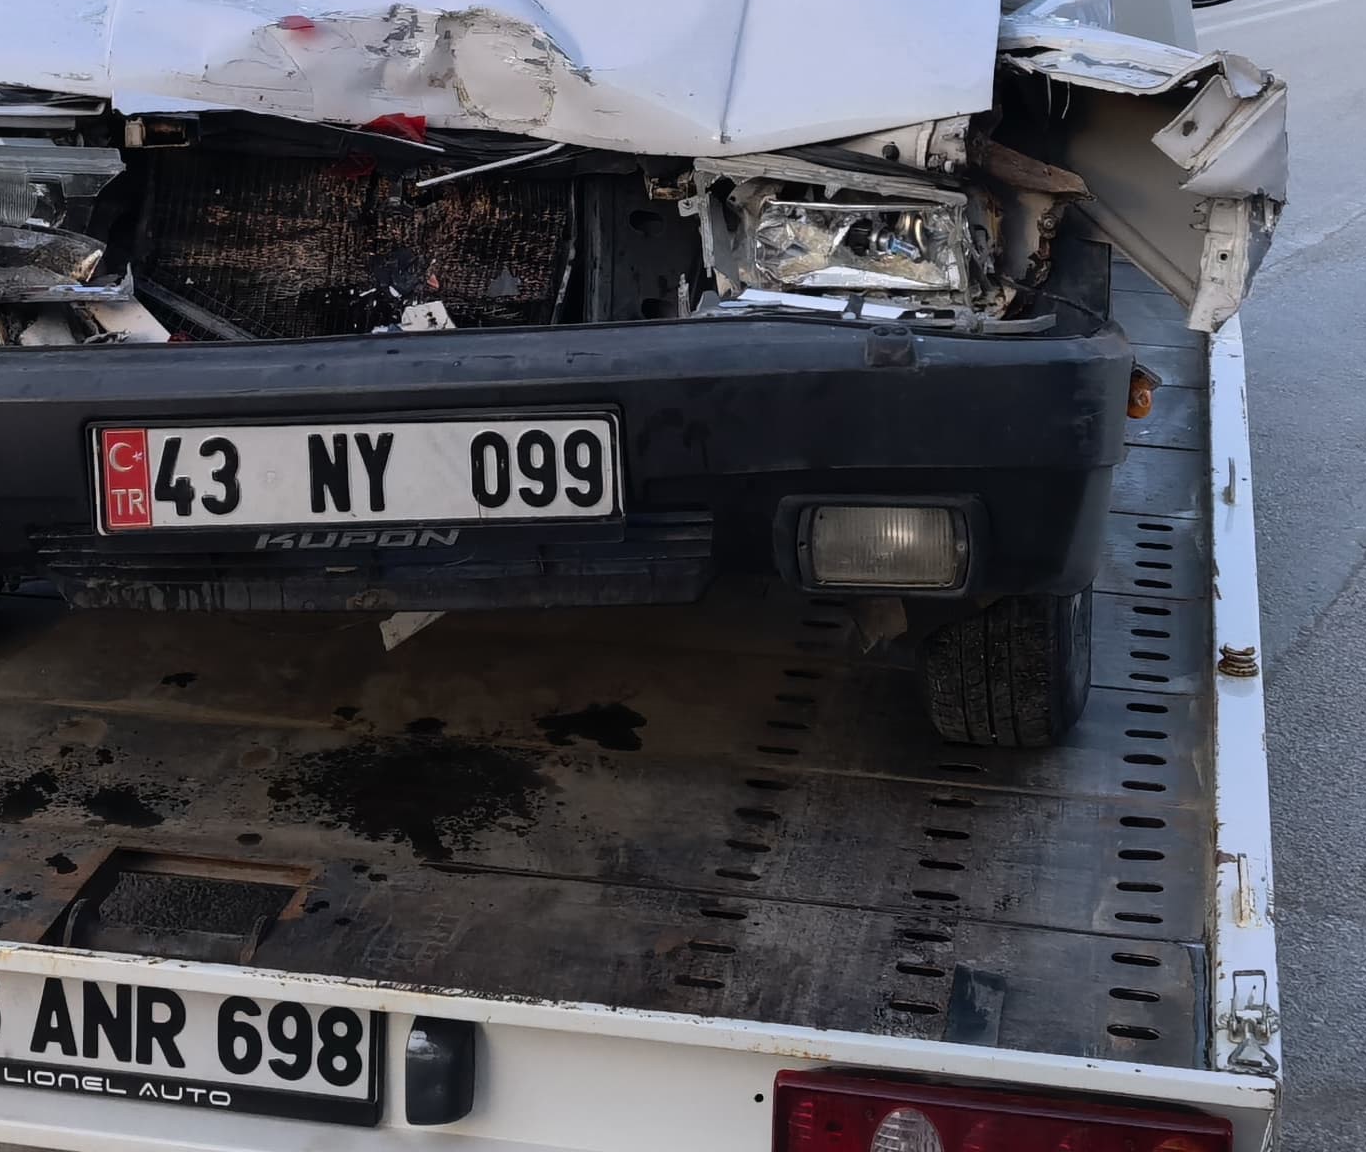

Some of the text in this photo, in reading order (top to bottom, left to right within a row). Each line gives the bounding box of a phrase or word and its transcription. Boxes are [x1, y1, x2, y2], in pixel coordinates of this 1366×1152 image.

[153, 428, 605, 517] 43 NY 099
[111, 487, 147, 518] TR
[254, 527, 461, 551] KUPON
[29, 976, 188, 1070] ANR
[216, 994, 365, 1088] 698
[3, 1066, 232, 1107] LIONEL AUTO
